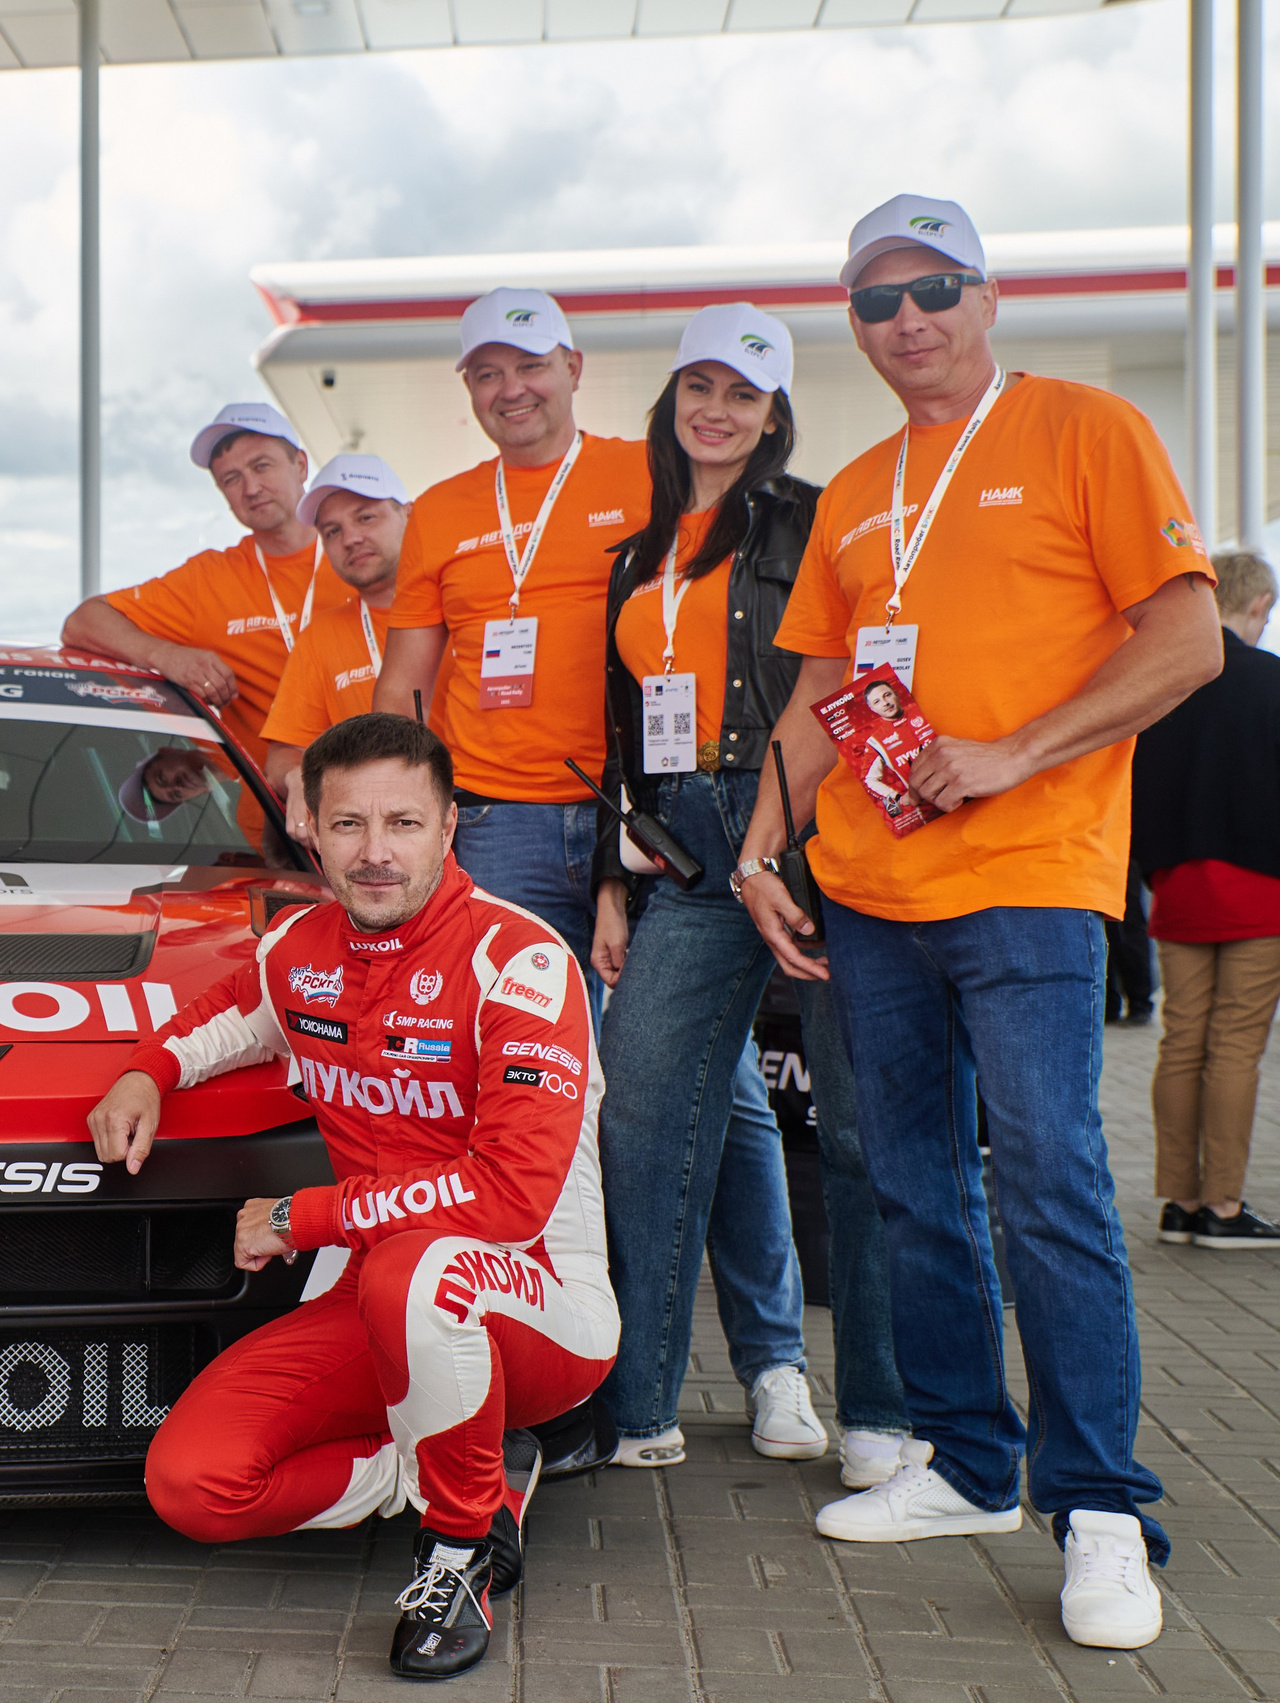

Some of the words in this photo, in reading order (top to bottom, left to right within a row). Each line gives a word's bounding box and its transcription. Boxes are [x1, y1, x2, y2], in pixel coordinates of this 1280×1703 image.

[980, 486, 1025, 501] НАИК
[13, 669, 77, 680] гонок
[349, 937, 403, 953] LUKOIL
[302, 975, 334, 989] РСКГ
[501, 976, 553, 1008] freem
[298, 1017, 344, 1040] YOKOHAMA
[395, 1015, 417, 1027] SMP
[417, 1018, 454, 1030] RACING
[385, 1034, 419, 1054] TCR
[418, 1042, 451, 1052] Russia
[502, 1041, 583, 1076] GENESIS
[301, 1056, 465, 1118] ЛУКОЙЛ
[506, 1070, 537, 1082] ЭКТО
[538, 1071, 578, 1099] 100
[342, 1172, 476, 1230] LUKOIL
[433, 1249, 545, 1325] ЛУКОЙЛ
